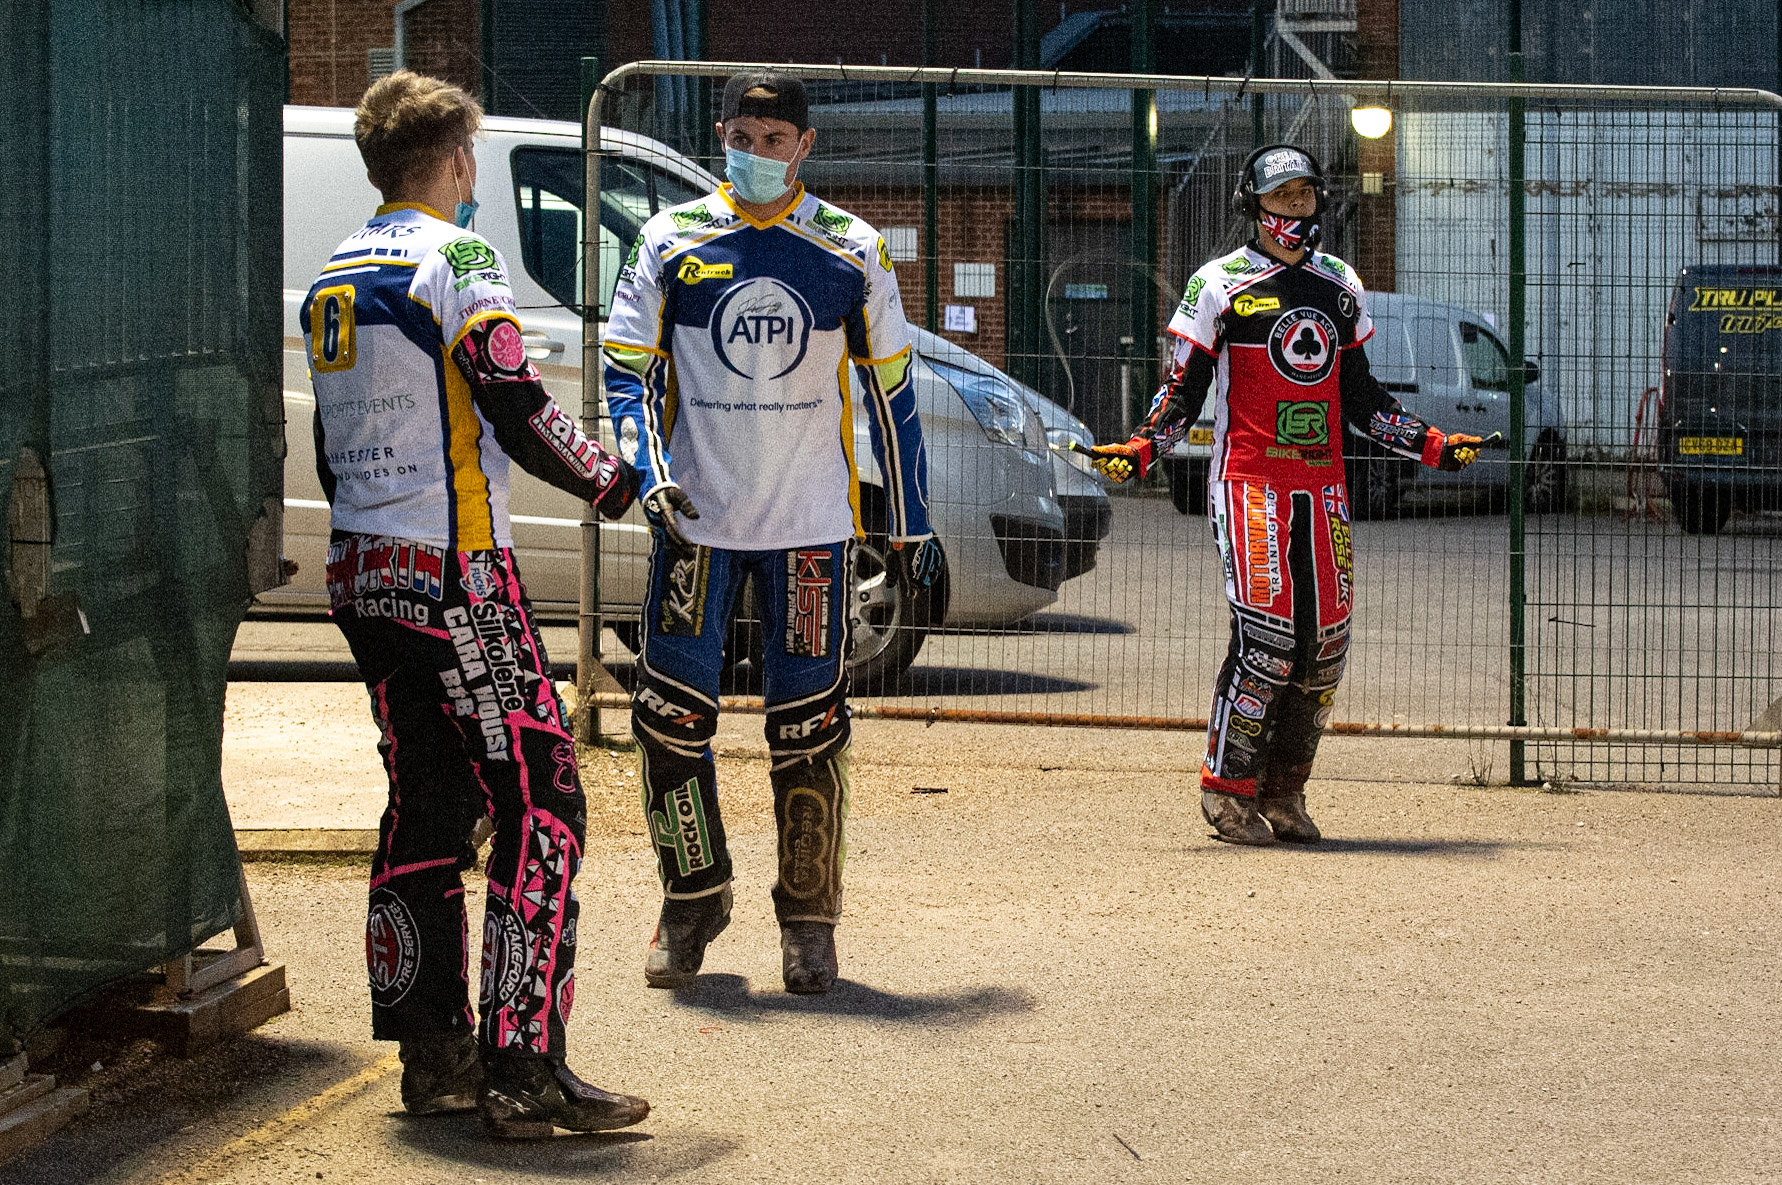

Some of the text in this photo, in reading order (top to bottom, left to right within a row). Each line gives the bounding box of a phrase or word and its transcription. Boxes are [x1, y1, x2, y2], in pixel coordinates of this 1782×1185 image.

[1341, 298, 1350, 310] 7
[323, 296, 340, 362] 6
[727, 315, 794, 345] ATPI
[1275, 311, 1335, 340] BELLE VUE ACES
[690, 398, 731, 412] Delivering
[734, 401, 757, 411] what
[759, 402, 783, 414] really
[534, 416, 556, 443] TIME
[397, 464, 417, 475] ON
[1268, 492, 1281, 594] TRAINING LTD
[1331, 517, 1350, 603] ROSE UK
[470, 566, 487, 597] FUCHS
[355, 592, 429, 626] Racing
[443, 605, 480, 682] CARA
[471, 602, 524, 711] Silkolene
[638, 687, 704, 730] RFX
[779, 703, 839, 740] RFX
[675, 785, 704, 870] ROCK OIL
[394, 958, 413, 991] TYRE
[500, 914, 524, 1001] STAKEFORD
